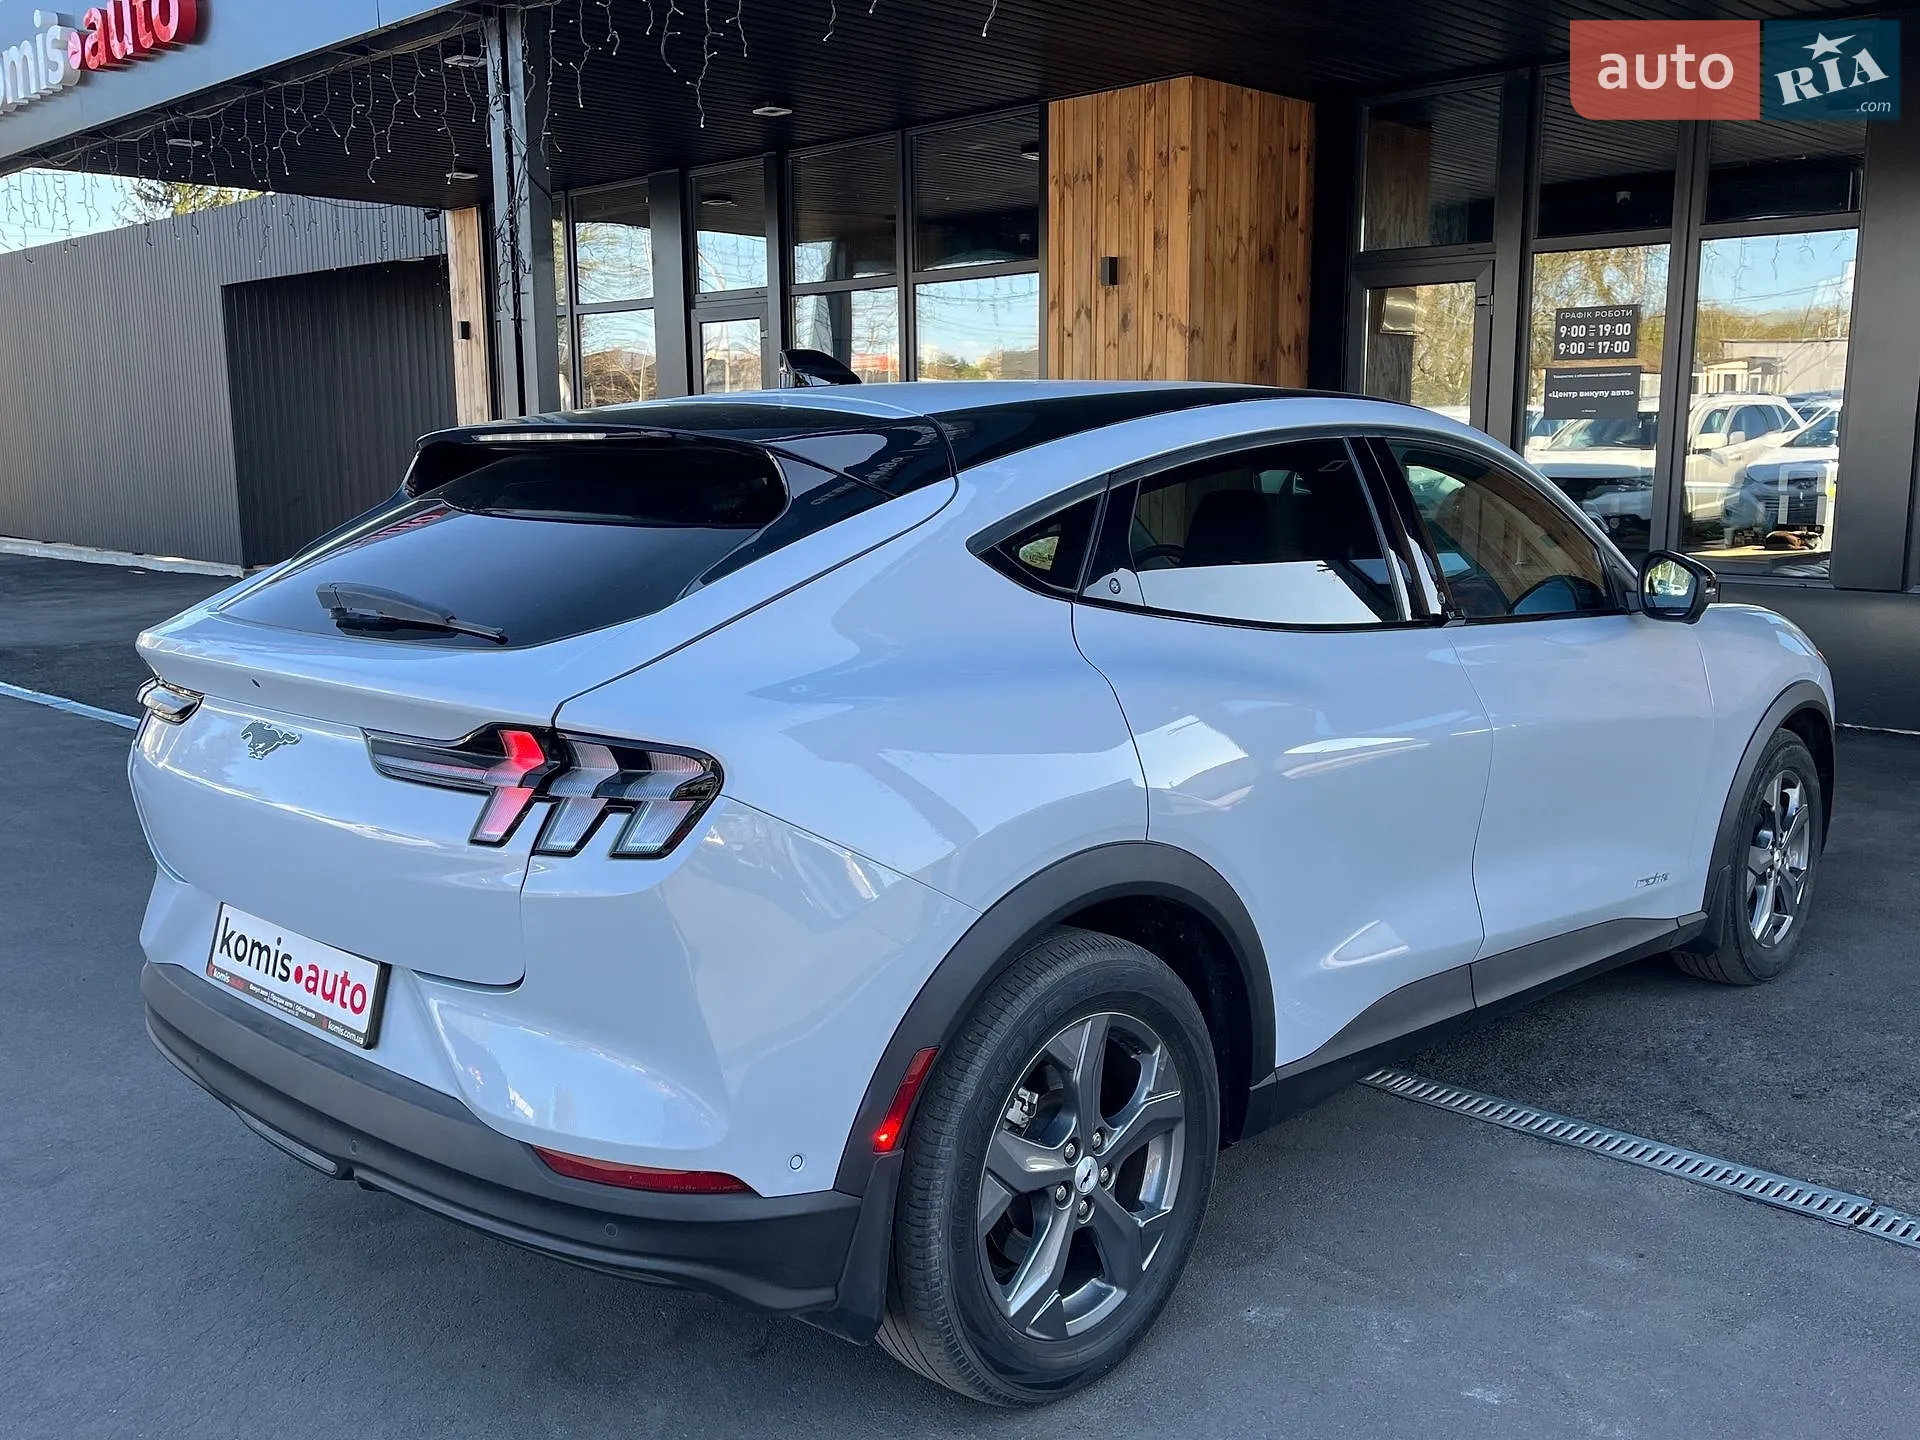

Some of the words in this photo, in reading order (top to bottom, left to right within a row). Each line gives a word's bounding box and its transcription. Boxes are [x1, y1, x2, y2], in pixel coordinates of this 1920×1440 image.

[0, 9, 66, 108] mis
[1560, 311, 1593, 319] ГРАФІК
[1595, 309, 1633, 318] РОБОТИ
[1559, 324, 1586, 338] 9:00
[1598, 323, 1631, 337] 19:00
[1558, 341, 1585, 355] 9:00
[1597, 340, 1630, 354] 17:00
[304, 963, 367, 1015] auto
